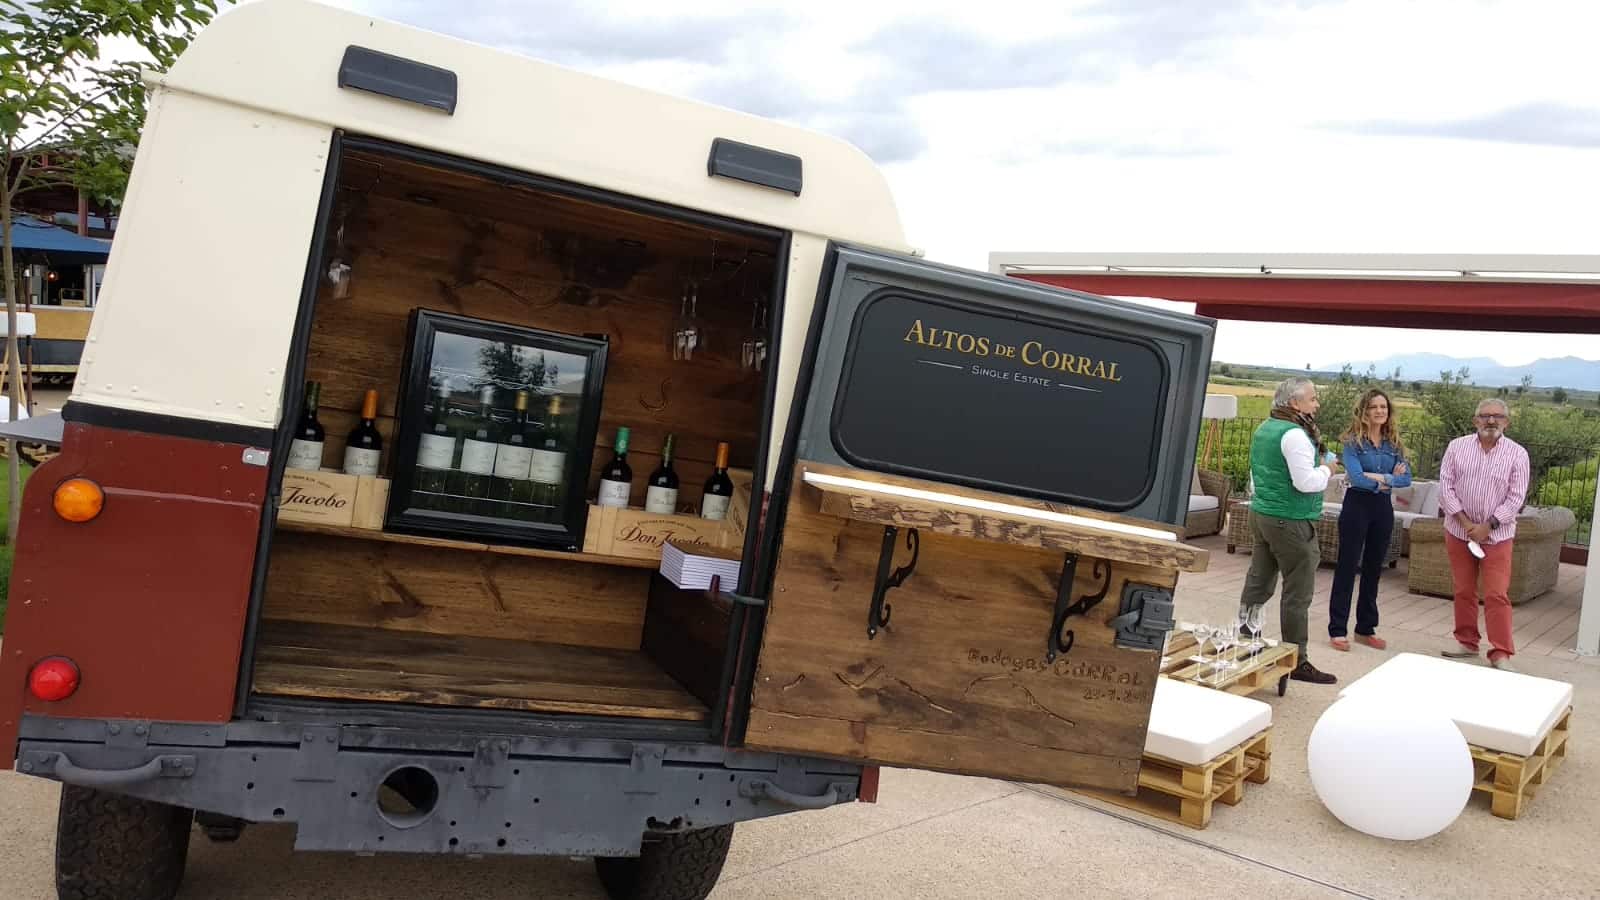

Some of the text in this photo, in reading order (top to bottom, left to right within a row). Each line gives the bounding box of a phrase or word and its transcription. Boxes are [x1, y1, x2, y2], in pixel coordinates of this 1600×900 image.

[904, 319, 1122, 382] ALTOS DE CORRAL
[971, 364, 1050, 387] SINGLE ESTATE
[280, 486, 346, 509] Jacobo
[615, 525, 657, 545] Don
